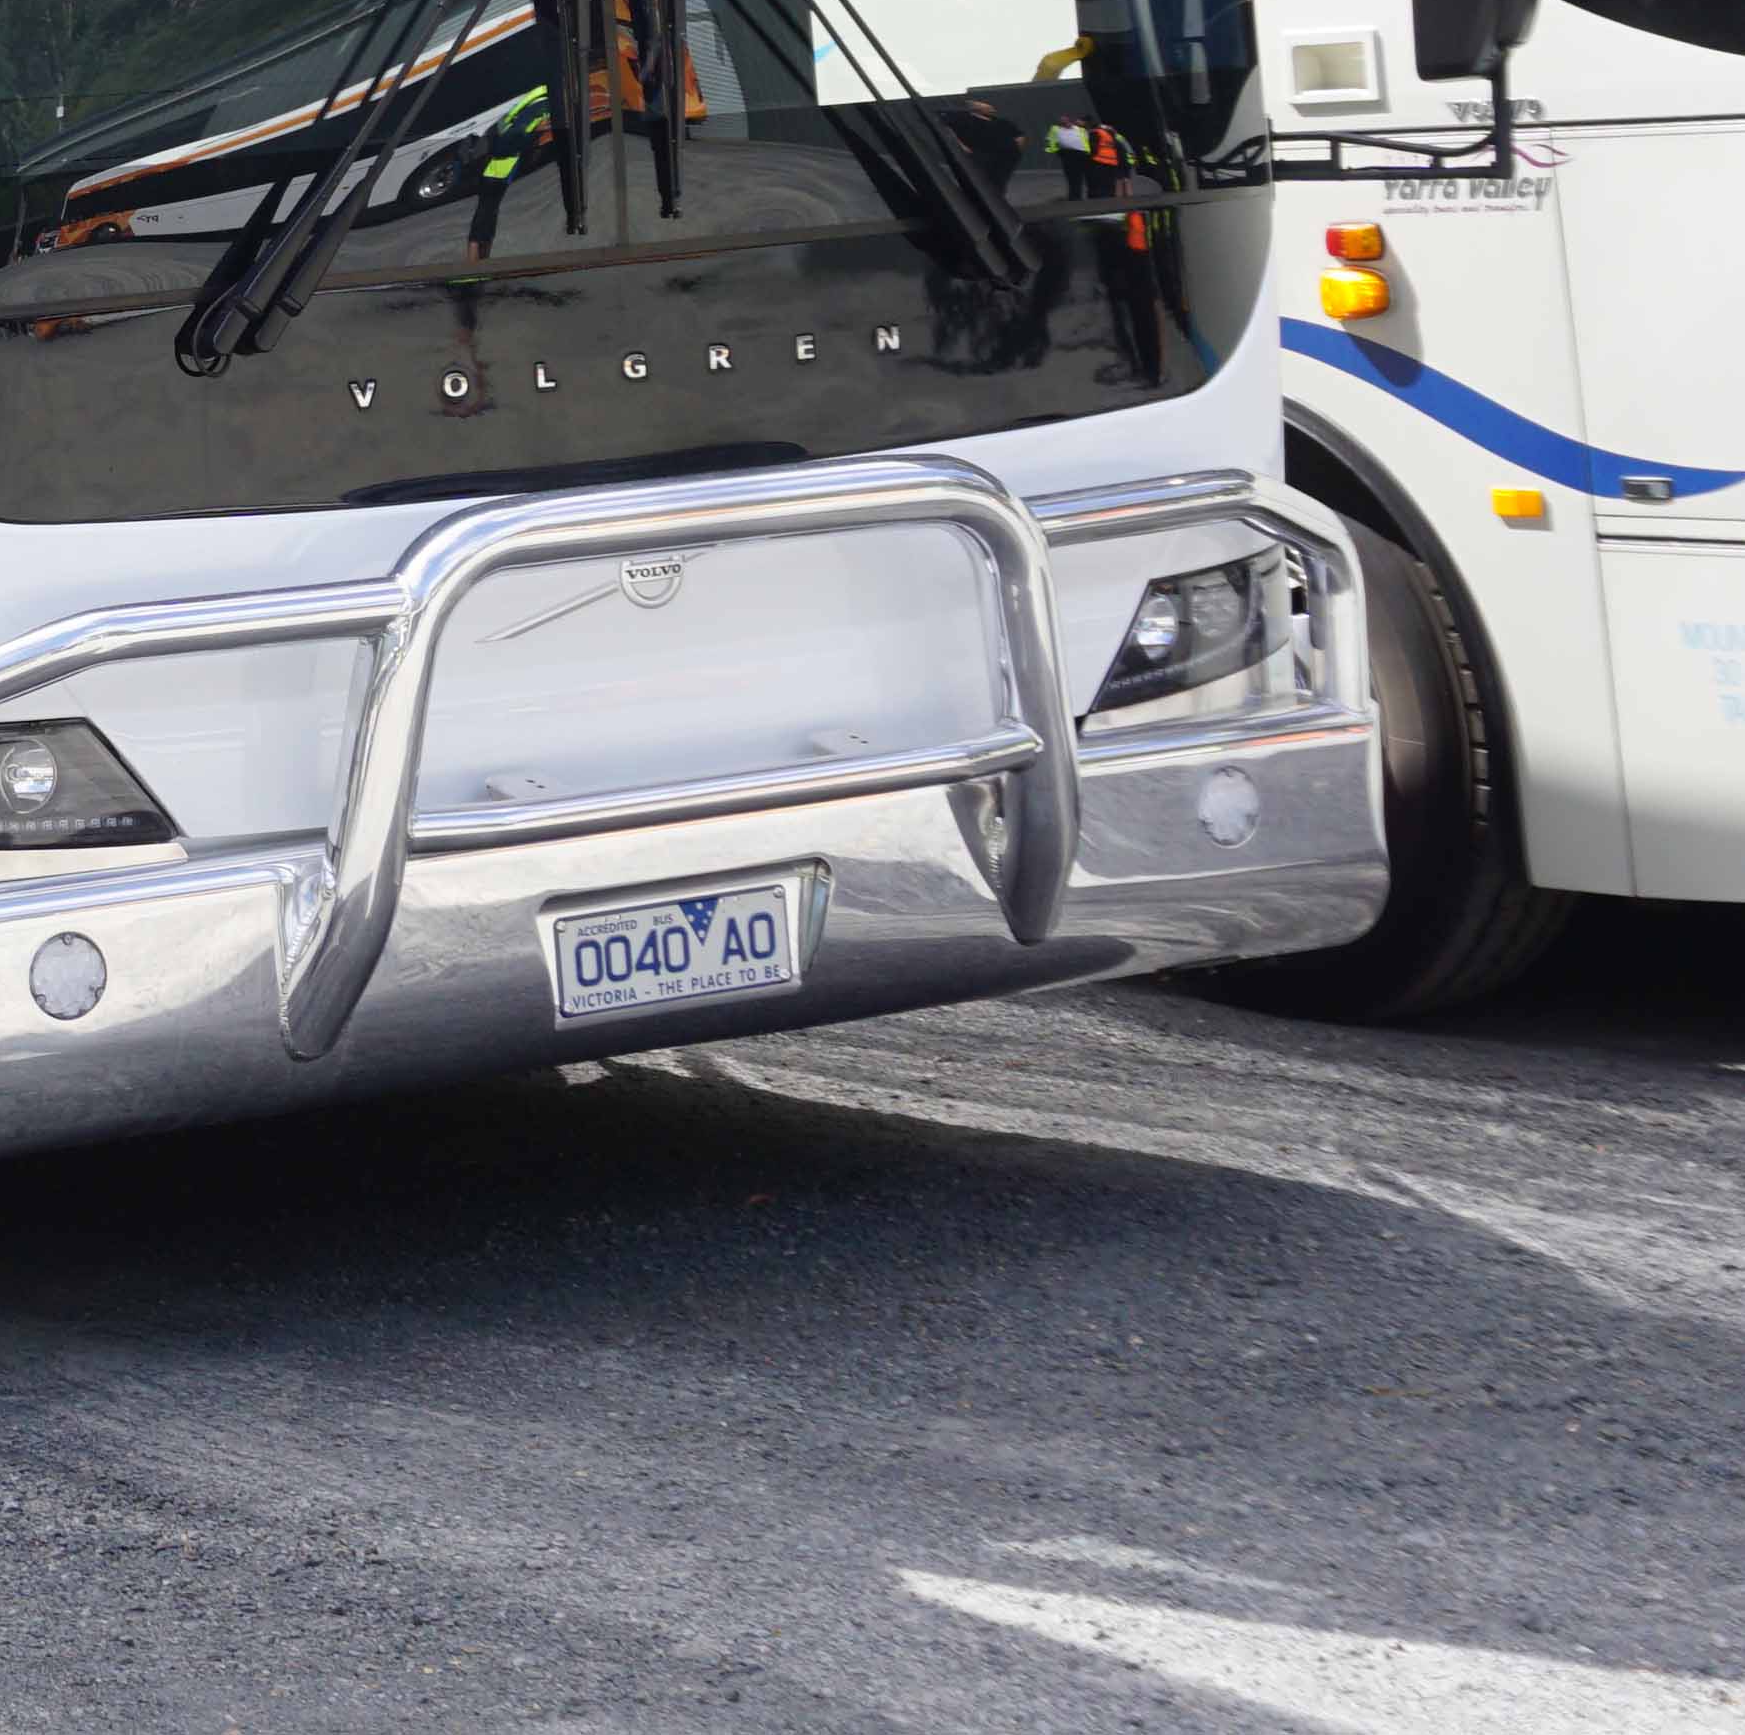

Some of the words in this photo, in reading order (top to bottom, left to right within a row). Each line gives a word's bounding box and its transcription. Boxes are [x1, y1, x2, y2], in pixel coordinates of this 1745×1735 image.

[349, 325, 901, 410] VOLGREN
[625, 564, 681, 579] VOLVO
[577, 920, 637, 937] ACCREDITED
[652, 914, 674, 926] BUS
[575, 925, 691, 987] 0040
[722, 912, 775, 965] AO
[572, 987, 637, 1009] VICTORIA
[658, 979, 684, 995] THE
[691, 972, 732, 989] PLACE
[739, 968, 756, 982] TO
[764, 965, 781, 979] BE
